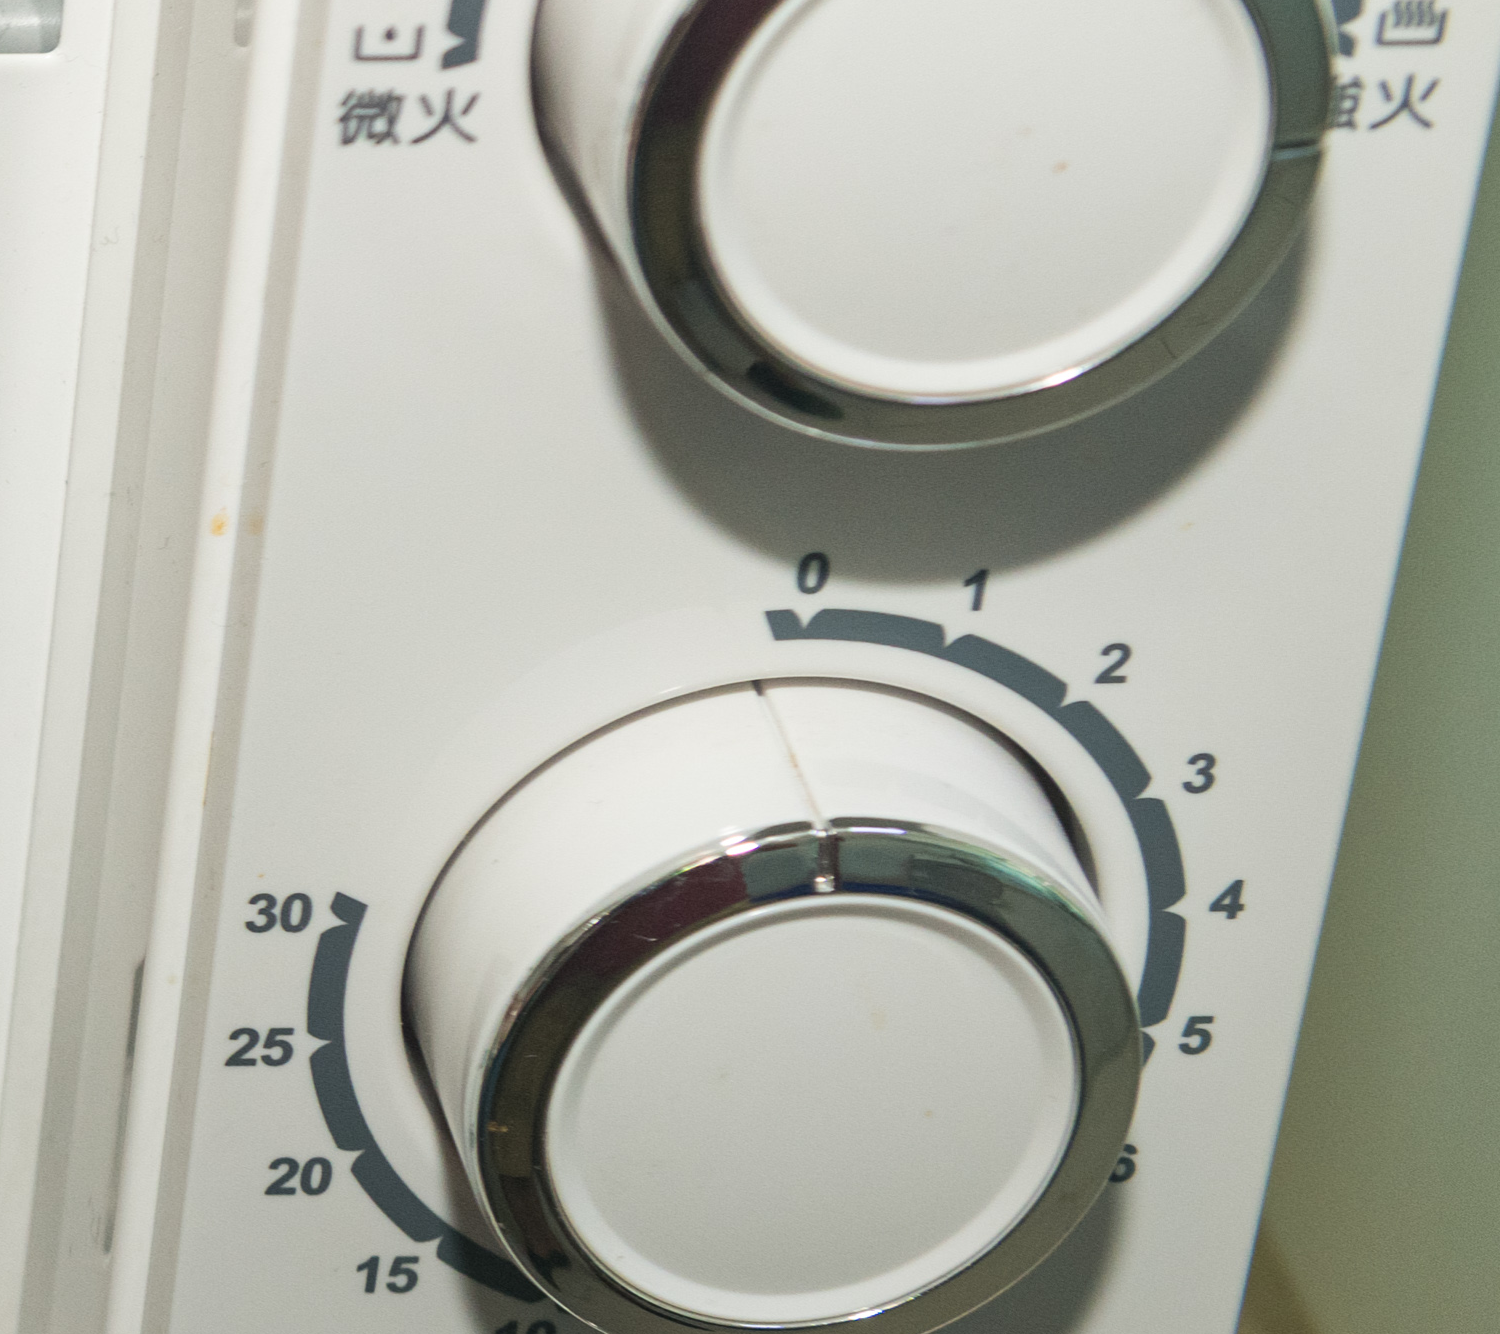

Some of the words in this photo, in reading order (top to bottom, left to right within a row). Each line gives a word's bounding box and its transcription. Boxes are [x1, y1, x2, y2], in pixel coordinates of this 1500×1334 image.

[336, 86, 481, 147] 微火
[795, 553, 831, 596] 0
[962, 569, 994, 612] 1
[1094, 642, 1134, 686] 2
[1181, 752, 1218, 794] 3
[244, 893, 314, 935] 30
[1209, 879, 1248, 921] 4
[223, 1027, 296, 1069] 25
[1176, 1015, 1215, 1056] 5
[264, 1157, 334, 1199] 20
[356, 1255, 420, 1294] 15
